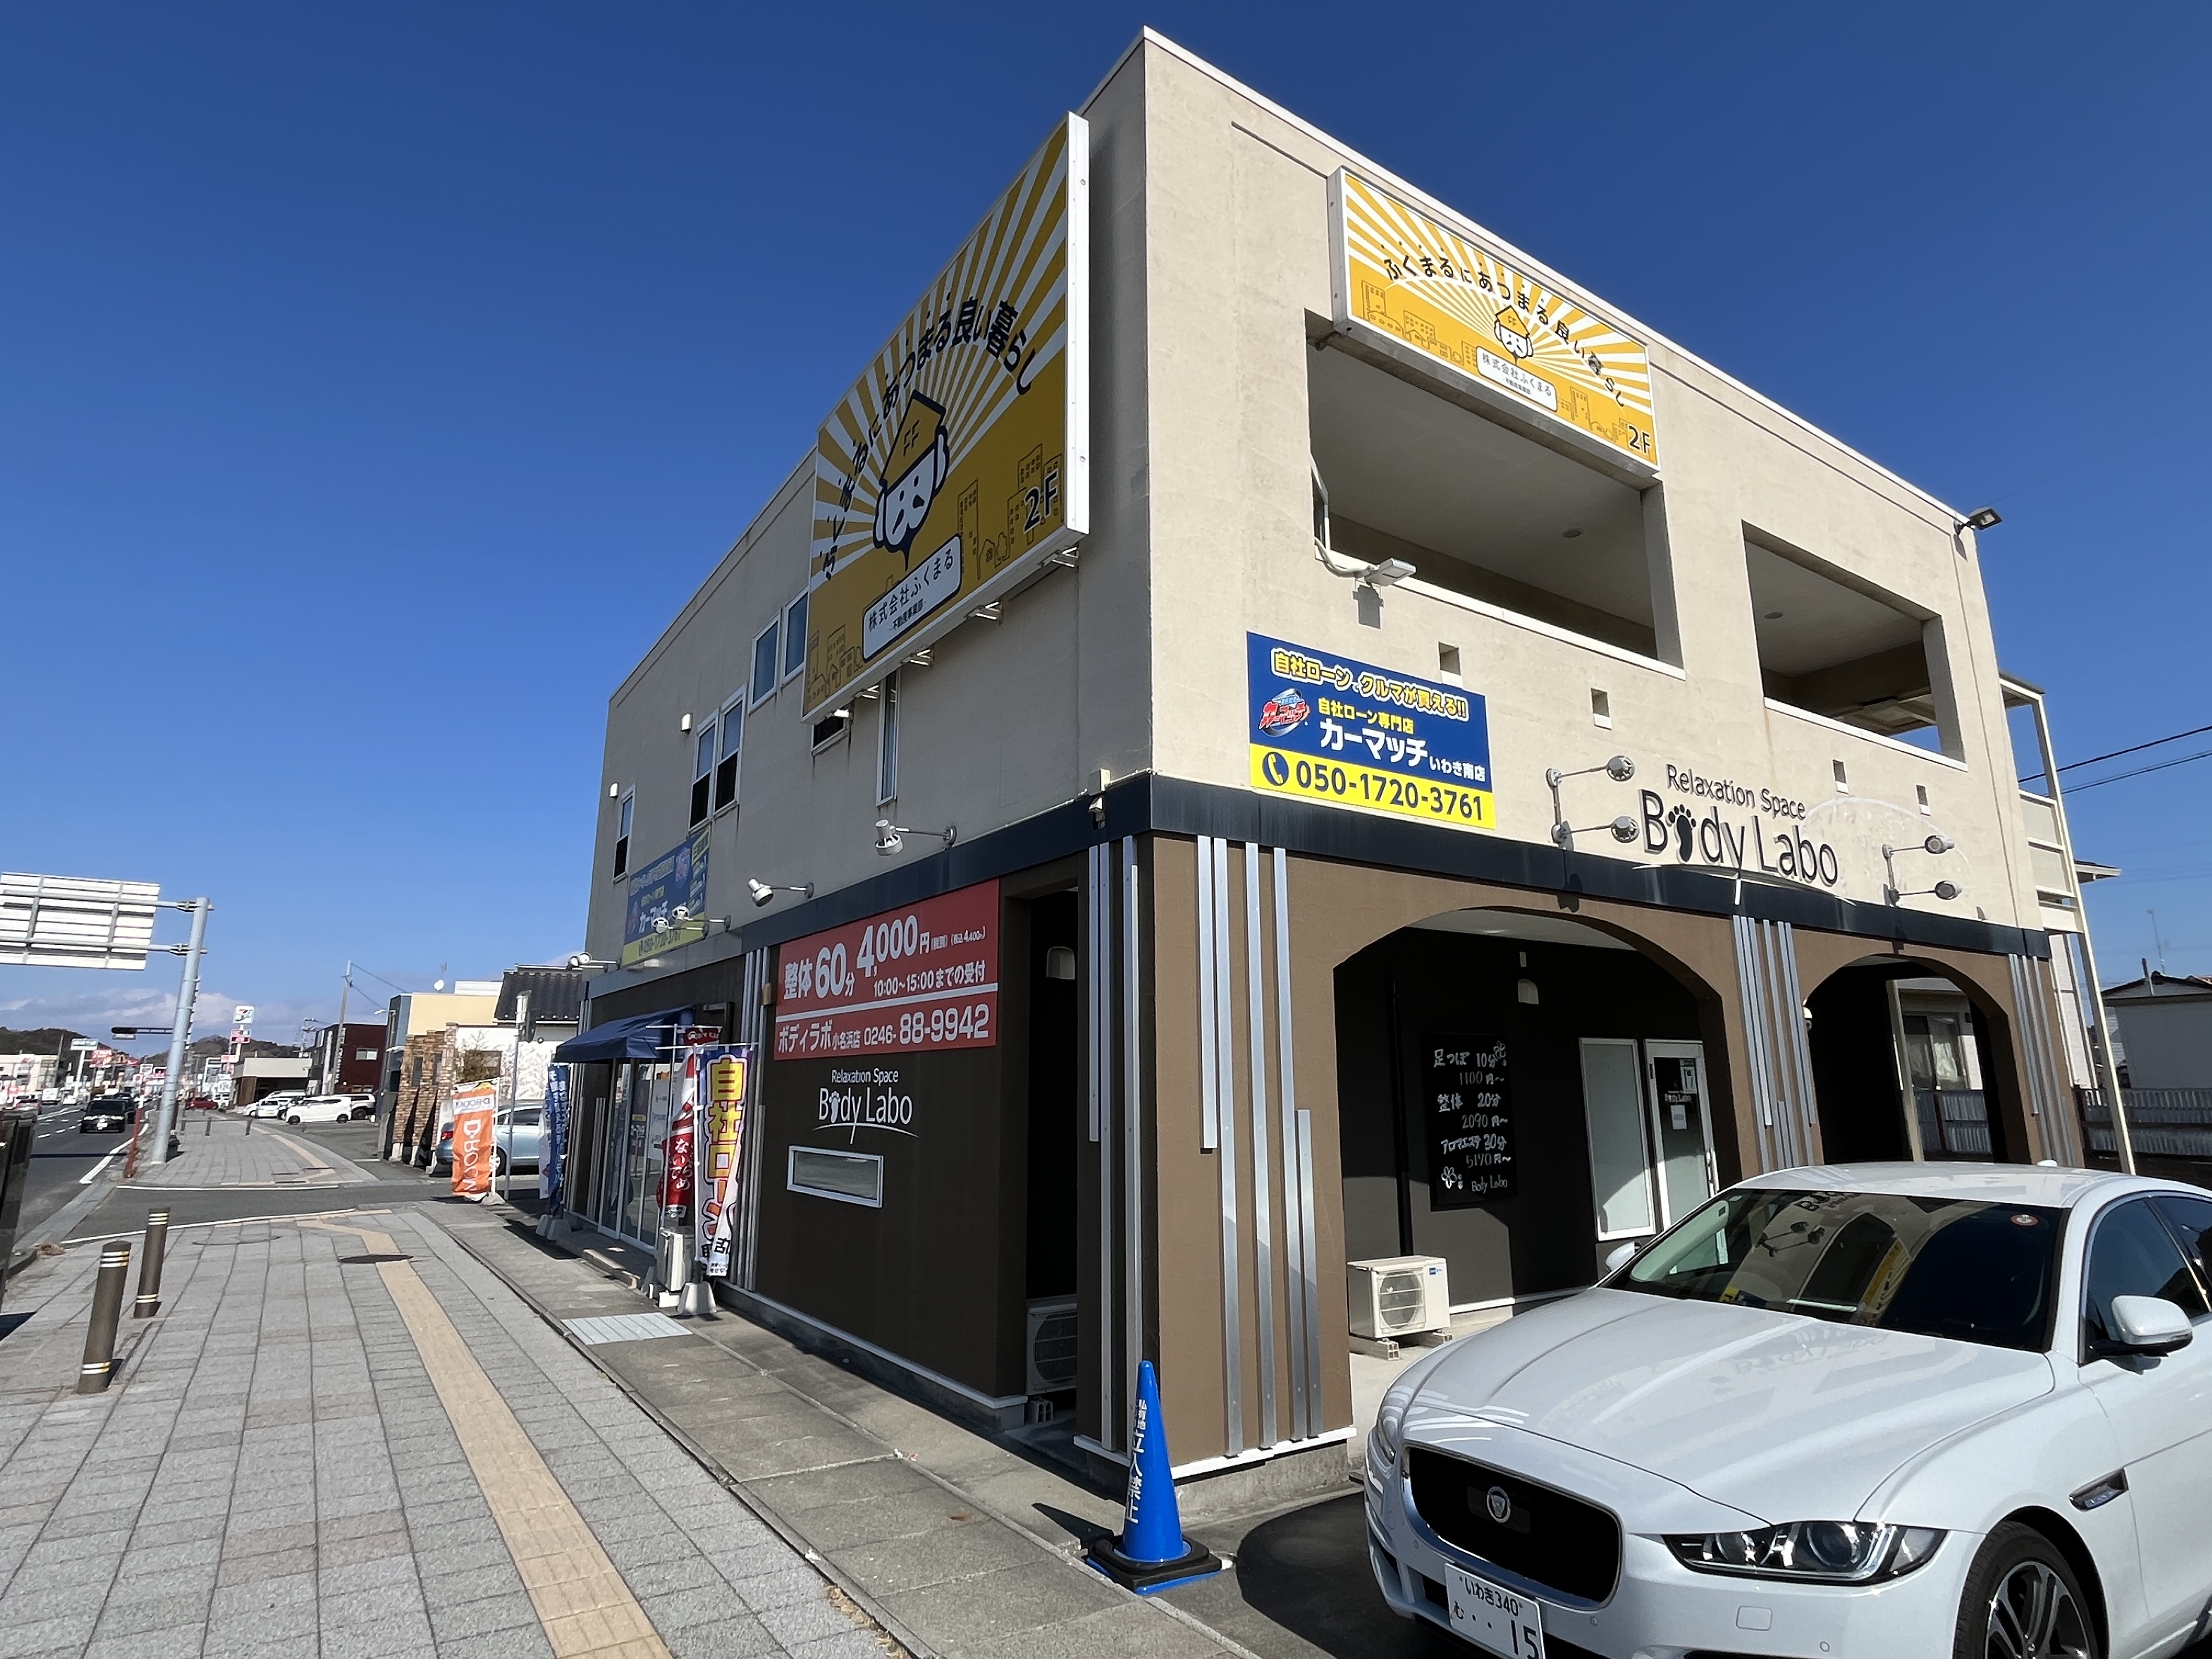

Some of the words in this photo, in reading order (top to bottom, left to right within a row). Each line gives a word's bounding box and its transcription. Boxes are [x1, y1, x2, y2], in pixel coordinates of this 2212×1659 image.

[1627, 425, 1651, 454] 2F
[1023, 470, 1058, 533] 2F
[868, 549, 953, 633] 株式会社ふくまる
[1318, 697, 1414, 735] 自社ローン専門店
[1319, 718, 1429, 768] カーマッチ
[1296, 760, 1483, 821] 050-1720-3761
[1666, 763, 1756, 809] Relaxation
[1760, 788, 1807, 821] Space
[1751, 815, 1839, 888] Labo
[1433, 1048, 1470, 1068] 足つぼ
[832, 1069, 871, 1084] Relaxation
[873, 1068, 899, 1087] Space
[866, 1086, 913, 1125] Labo
[1437, 1093, 1464, 1113] 整体
[1477, 1092, 1501, 1108] 20分
[1483, 1133, 1508, 1151] 30分
[1471, 1176, 1488, 1194] Body
[1489, 1173, 1508, 1188] Labo
